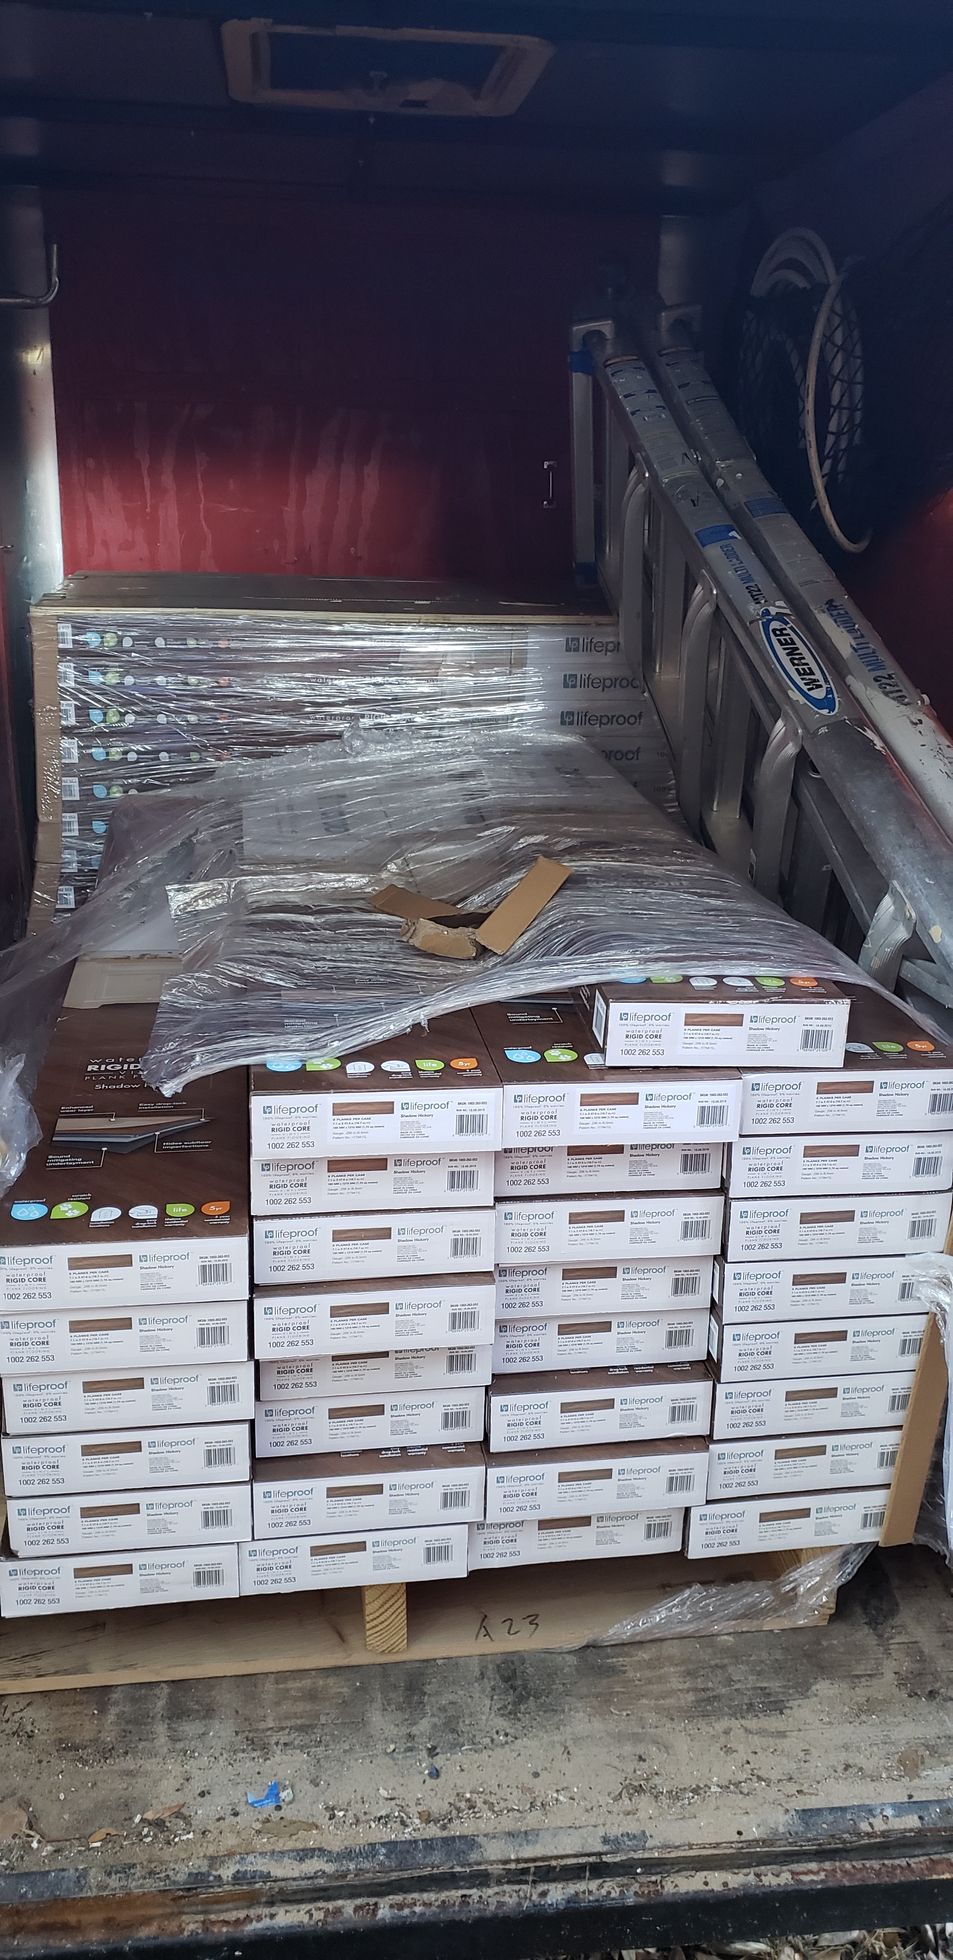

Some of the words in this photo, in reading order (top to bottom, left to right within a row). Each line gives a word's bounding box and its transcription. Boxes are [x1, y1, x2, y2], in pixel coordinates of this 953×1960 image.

[772, 627, 823, 691] WERNER
[849, 640, 886, 673] MULTI
[580, 674, 640, 692] lifeproo
[577, 711, 643, 728] lifeproof
[629, 1011, 671, 1023] lifeproof
[758, 1014, 797, 1025] lifeproof
[760, 1081, 802, 1092] lifeproof
[888, 1079, 925, 1090] lifeproof
[523, 1092, 566, 1104] lifeproof
[654, 1091, 692, 1102] lifeproof
[273, 1102, 318, 1115] lifeproof
[410, 1100, 449, 1111] lifeproof
[768, 1116, 781, 1124] 262
[533, 1129, 546, 1137] 262
[547, 1128, 560, 1136] 553
[267, 1141, 284, 1149] 1002
[285, 1140, 300, 1149] 262
[301, 1139, 314, 1147] 553
[873, 1143, 910, 1154] lifeproof
[751, 1144, 792, 1156] lifeproof
[271, 1160, 314, 1172] lifeproof
[402, 1156, 441, 1168] lifeproof
[513, 1210, 554, 1221] lifeproof
[638, 1208, 675, 1219] lifeproof
[749, 1208, 788, 1219] lifeproof
[274, 1227, 318, 1239] lifeproof
[406, 1224, 444, 1236] lifeproof
[757, 1242, 769, 1250] 262
[770, 1241, 782, 1249] 553
[6, 1255, 52, 1266] lifeproof
[148, 1251, 189, 1263] lifeproof
[507, 1267, 547, 1278] lifeproof
[630, 1265, 666, 1275] lifeproof
[742, 1270, 781, 1281] lifeproof
[860, 1270, 895, 1280] lifeproof
[37, 1291, 52, 1299] 553
[273, 1304, 316, 1316] lifeproof
[404, 1299, 442, 1310] lifeproof
[10, 1319, 55, 1330] lifeproof
[147, 1314, 188, 1326] lifeproof
[508, 1322, 547, 1333] lifeproof
[860, 1327, 895, 1337] lifeproof
[741, 1331, 780, 1342] lifeproof
[268, 1340, 285, 1348] 1002
[286, 1339, 299, 1347] 262
[300, 1338, 313, 1346] 553
[159, 1373, 198, 1385] lifeproof
[23, 1380, 67, 1392] lifeproof
[628, 1394, 663, 1405] lifeproof
[733, 1389, 772, 1399] lifeproof
[398, 1400, 434, 1411] lifeproof
[509, 1401, 548, 1412] lifeproof
[274, 1406, 315, 1417] lifeproof
[519, 1433, 531, 1441] 262
[22, 1444, 65, 1455] lifeproof
[839, 1440, 873, 1451] lifeproof
[726, 1448, 763, 1460] lifeproof
[505, 1472, 545, 1483] lifeproof
[272, 1486, 313, 1498] lifeproof
[154, 1499, 193, 1510] lifeproof
[27, 1505, 70, 1516] lifeproof
[708, 1510, 745, 1521] lifeproof
[604, 1512, 639, 1522] lifeproof
[485, 1519, 524, 1530] lifeproof
[380, 1536, 416, 1547] lifeproof
[257, 1545, 298, 1557] lifeproof
[18, 1566, 60, 1577] lifeproof
[501, 1613, 540, 1638] 23
